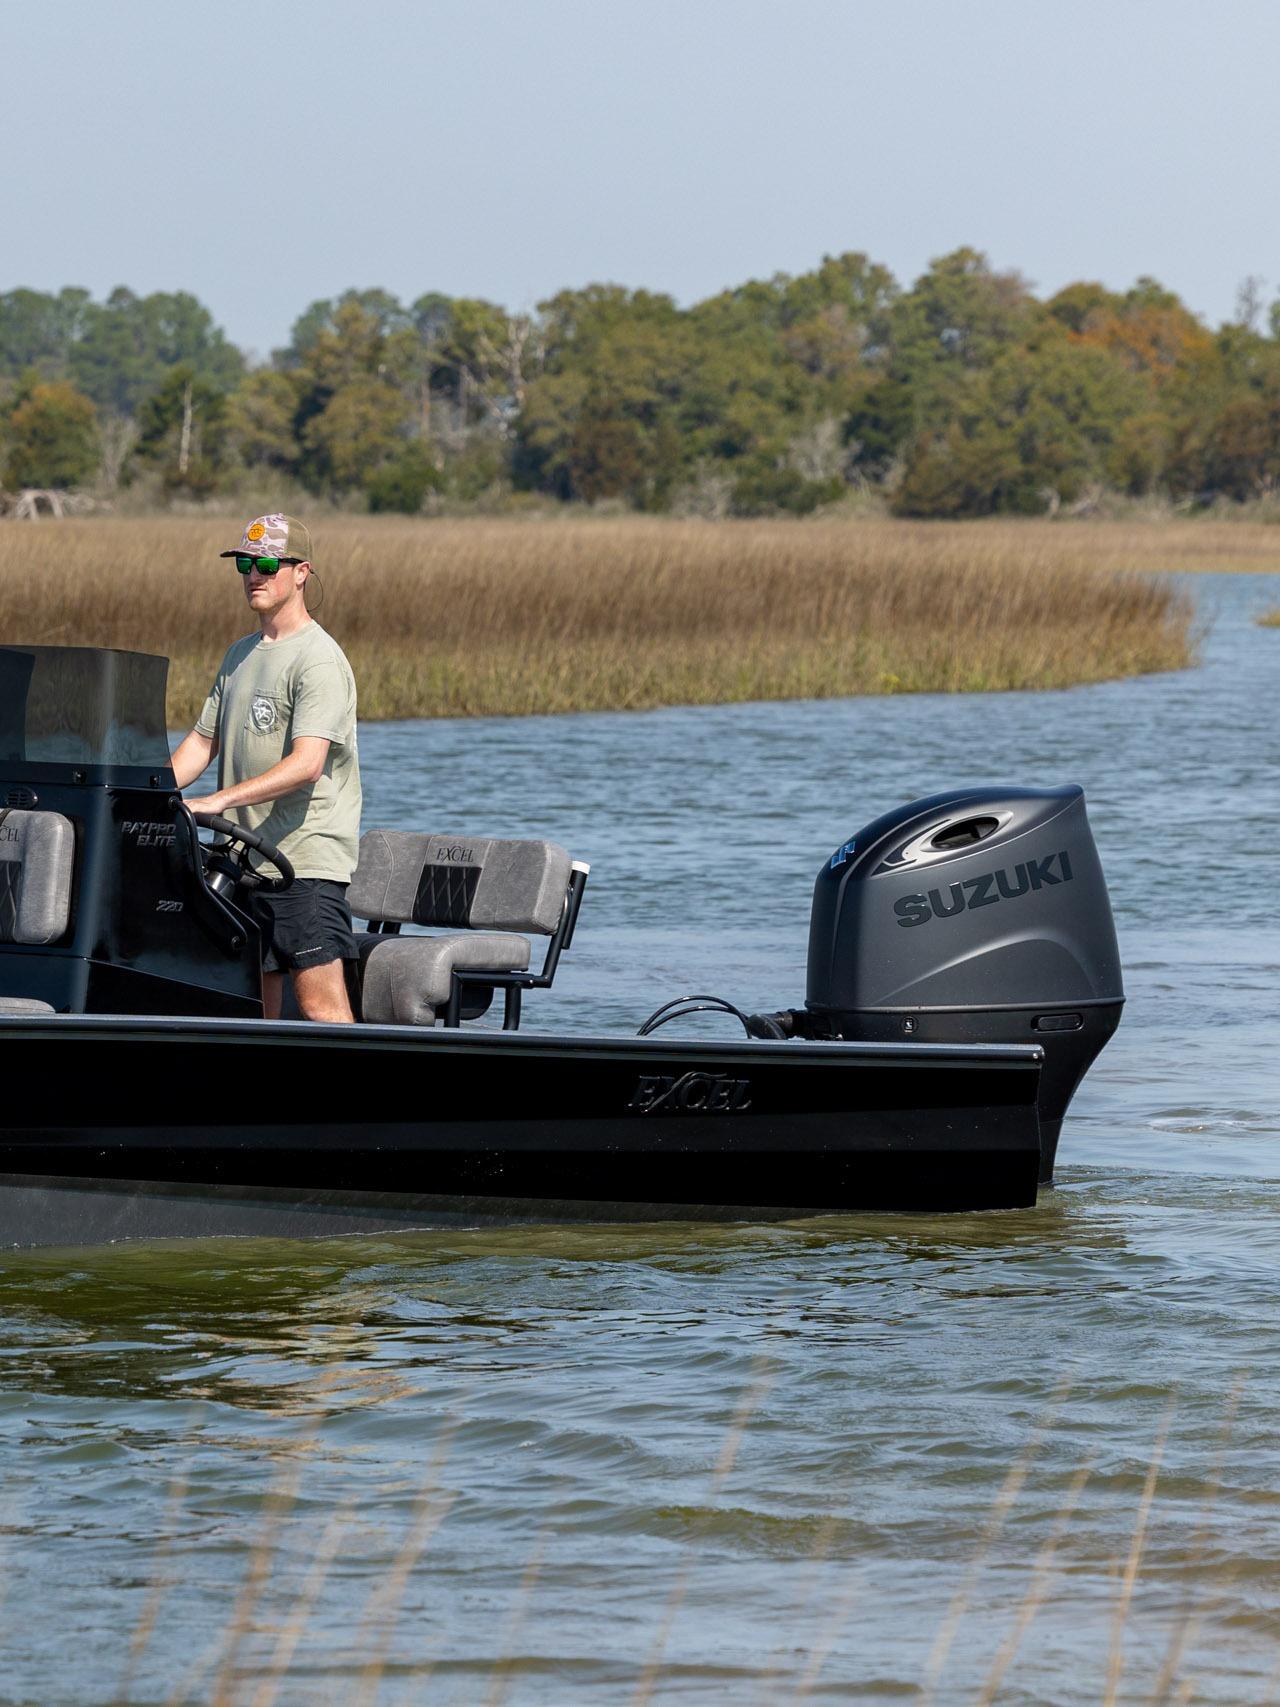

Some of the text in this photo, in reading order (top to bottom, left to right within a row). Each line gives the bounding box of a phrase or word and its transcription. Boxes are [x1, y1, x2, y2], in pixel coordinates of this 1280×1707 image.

[121, 821, 148, 834] BAY
[136, 835, 177, 847] ELITE
[436, 845, 474, 862] EXCEL
[893, 851, 1074, 928] SUZUKI
[626, 1070, 752, 1113] EXCEL
